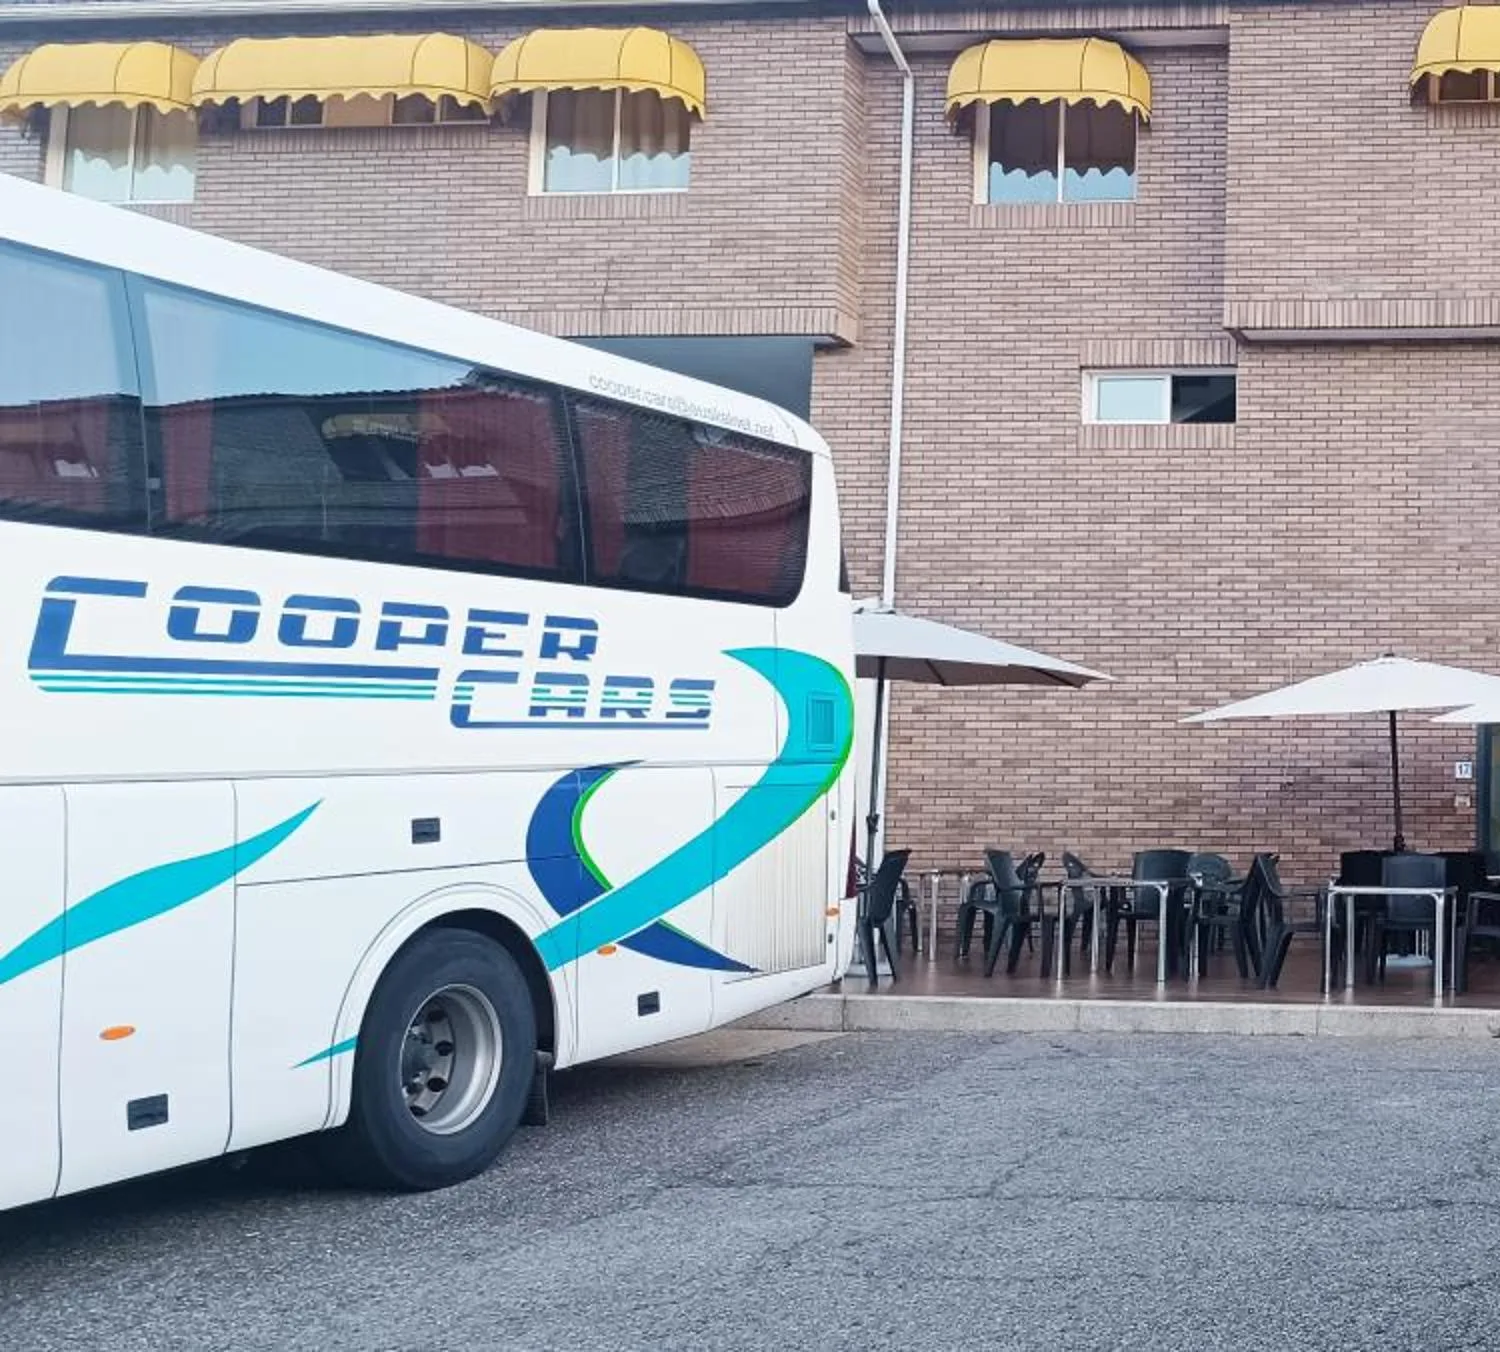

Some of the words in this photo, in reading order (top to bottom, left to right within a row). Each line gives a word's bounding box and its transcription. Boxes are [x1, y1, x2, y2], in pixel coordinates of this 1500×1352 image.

[28, 575, 599, 692] COOPER
[450, 669, 714, 729] CARS
[1457, 763, 1471, 776] 17
